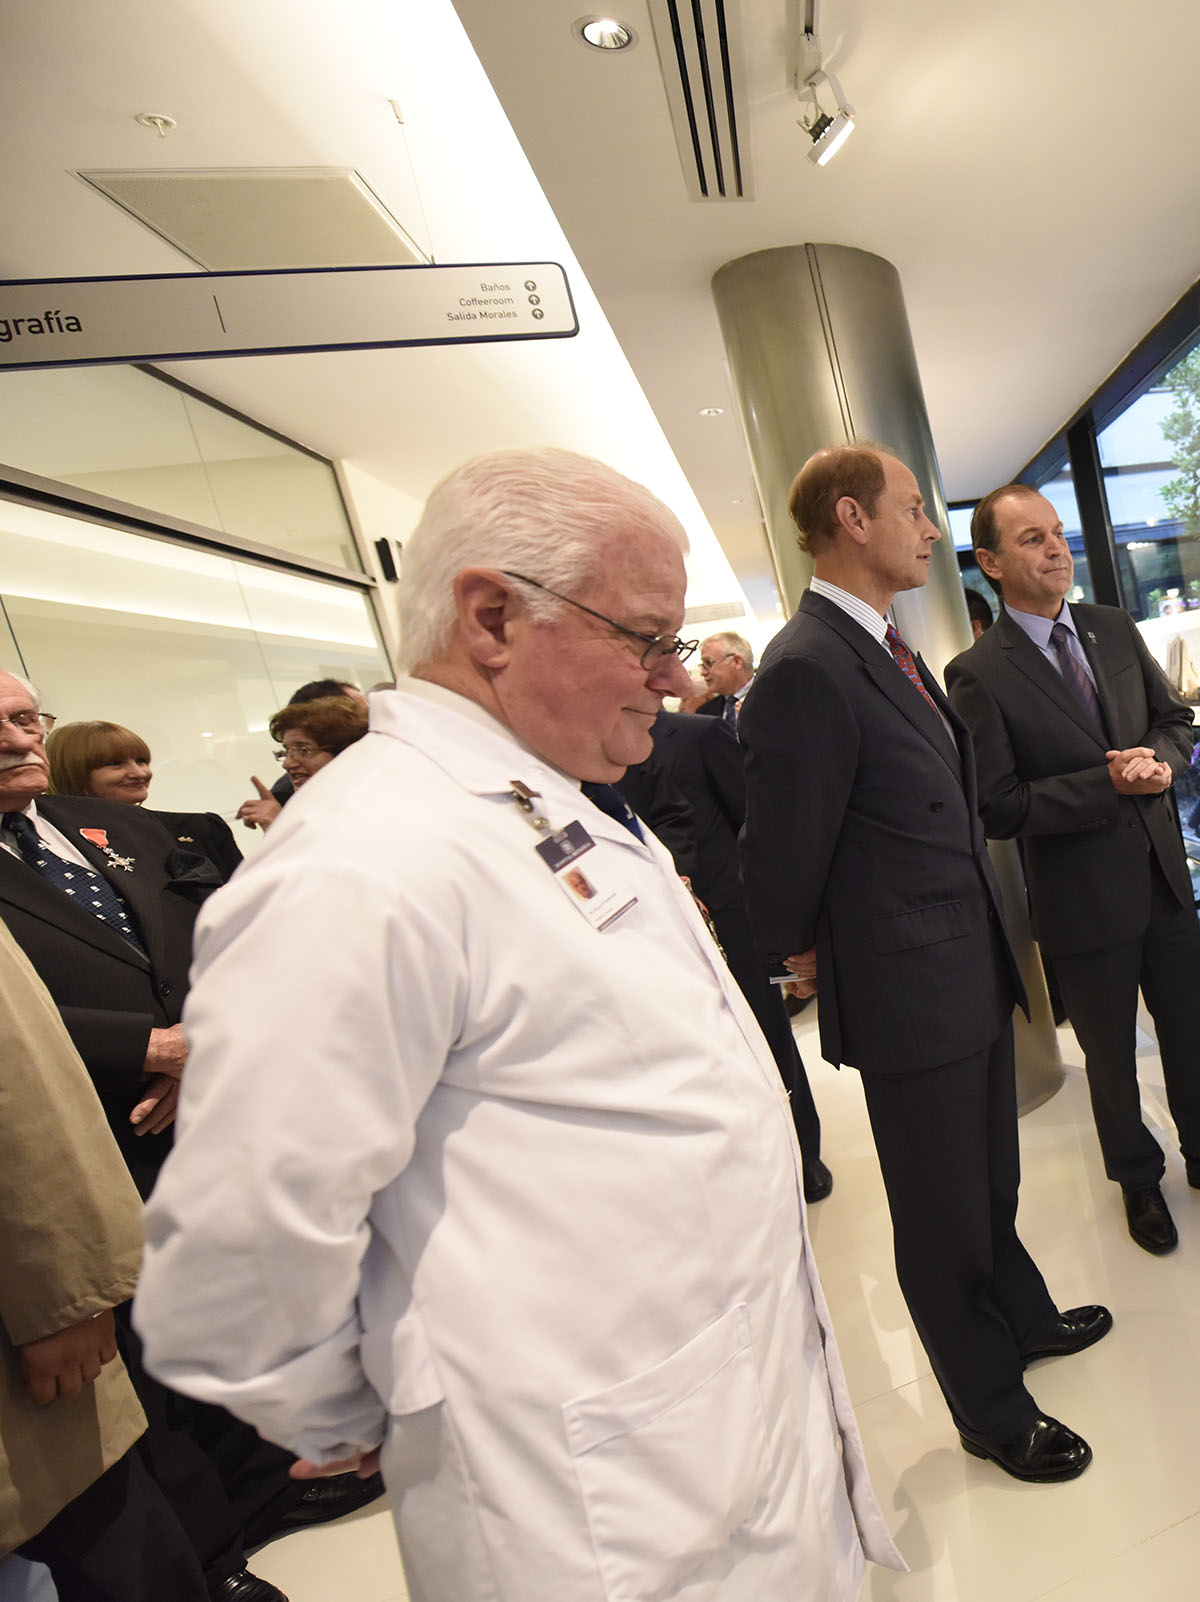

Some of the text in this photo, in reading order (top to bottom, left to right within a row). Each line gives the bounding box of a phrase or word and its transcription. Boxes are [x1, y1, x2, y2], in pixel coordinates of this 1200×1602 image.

[480, 282, 511, 292] Baños
[459, 297, 514, 306] Coffeeroom
[447, 311, 517, 321] Salida Morales
